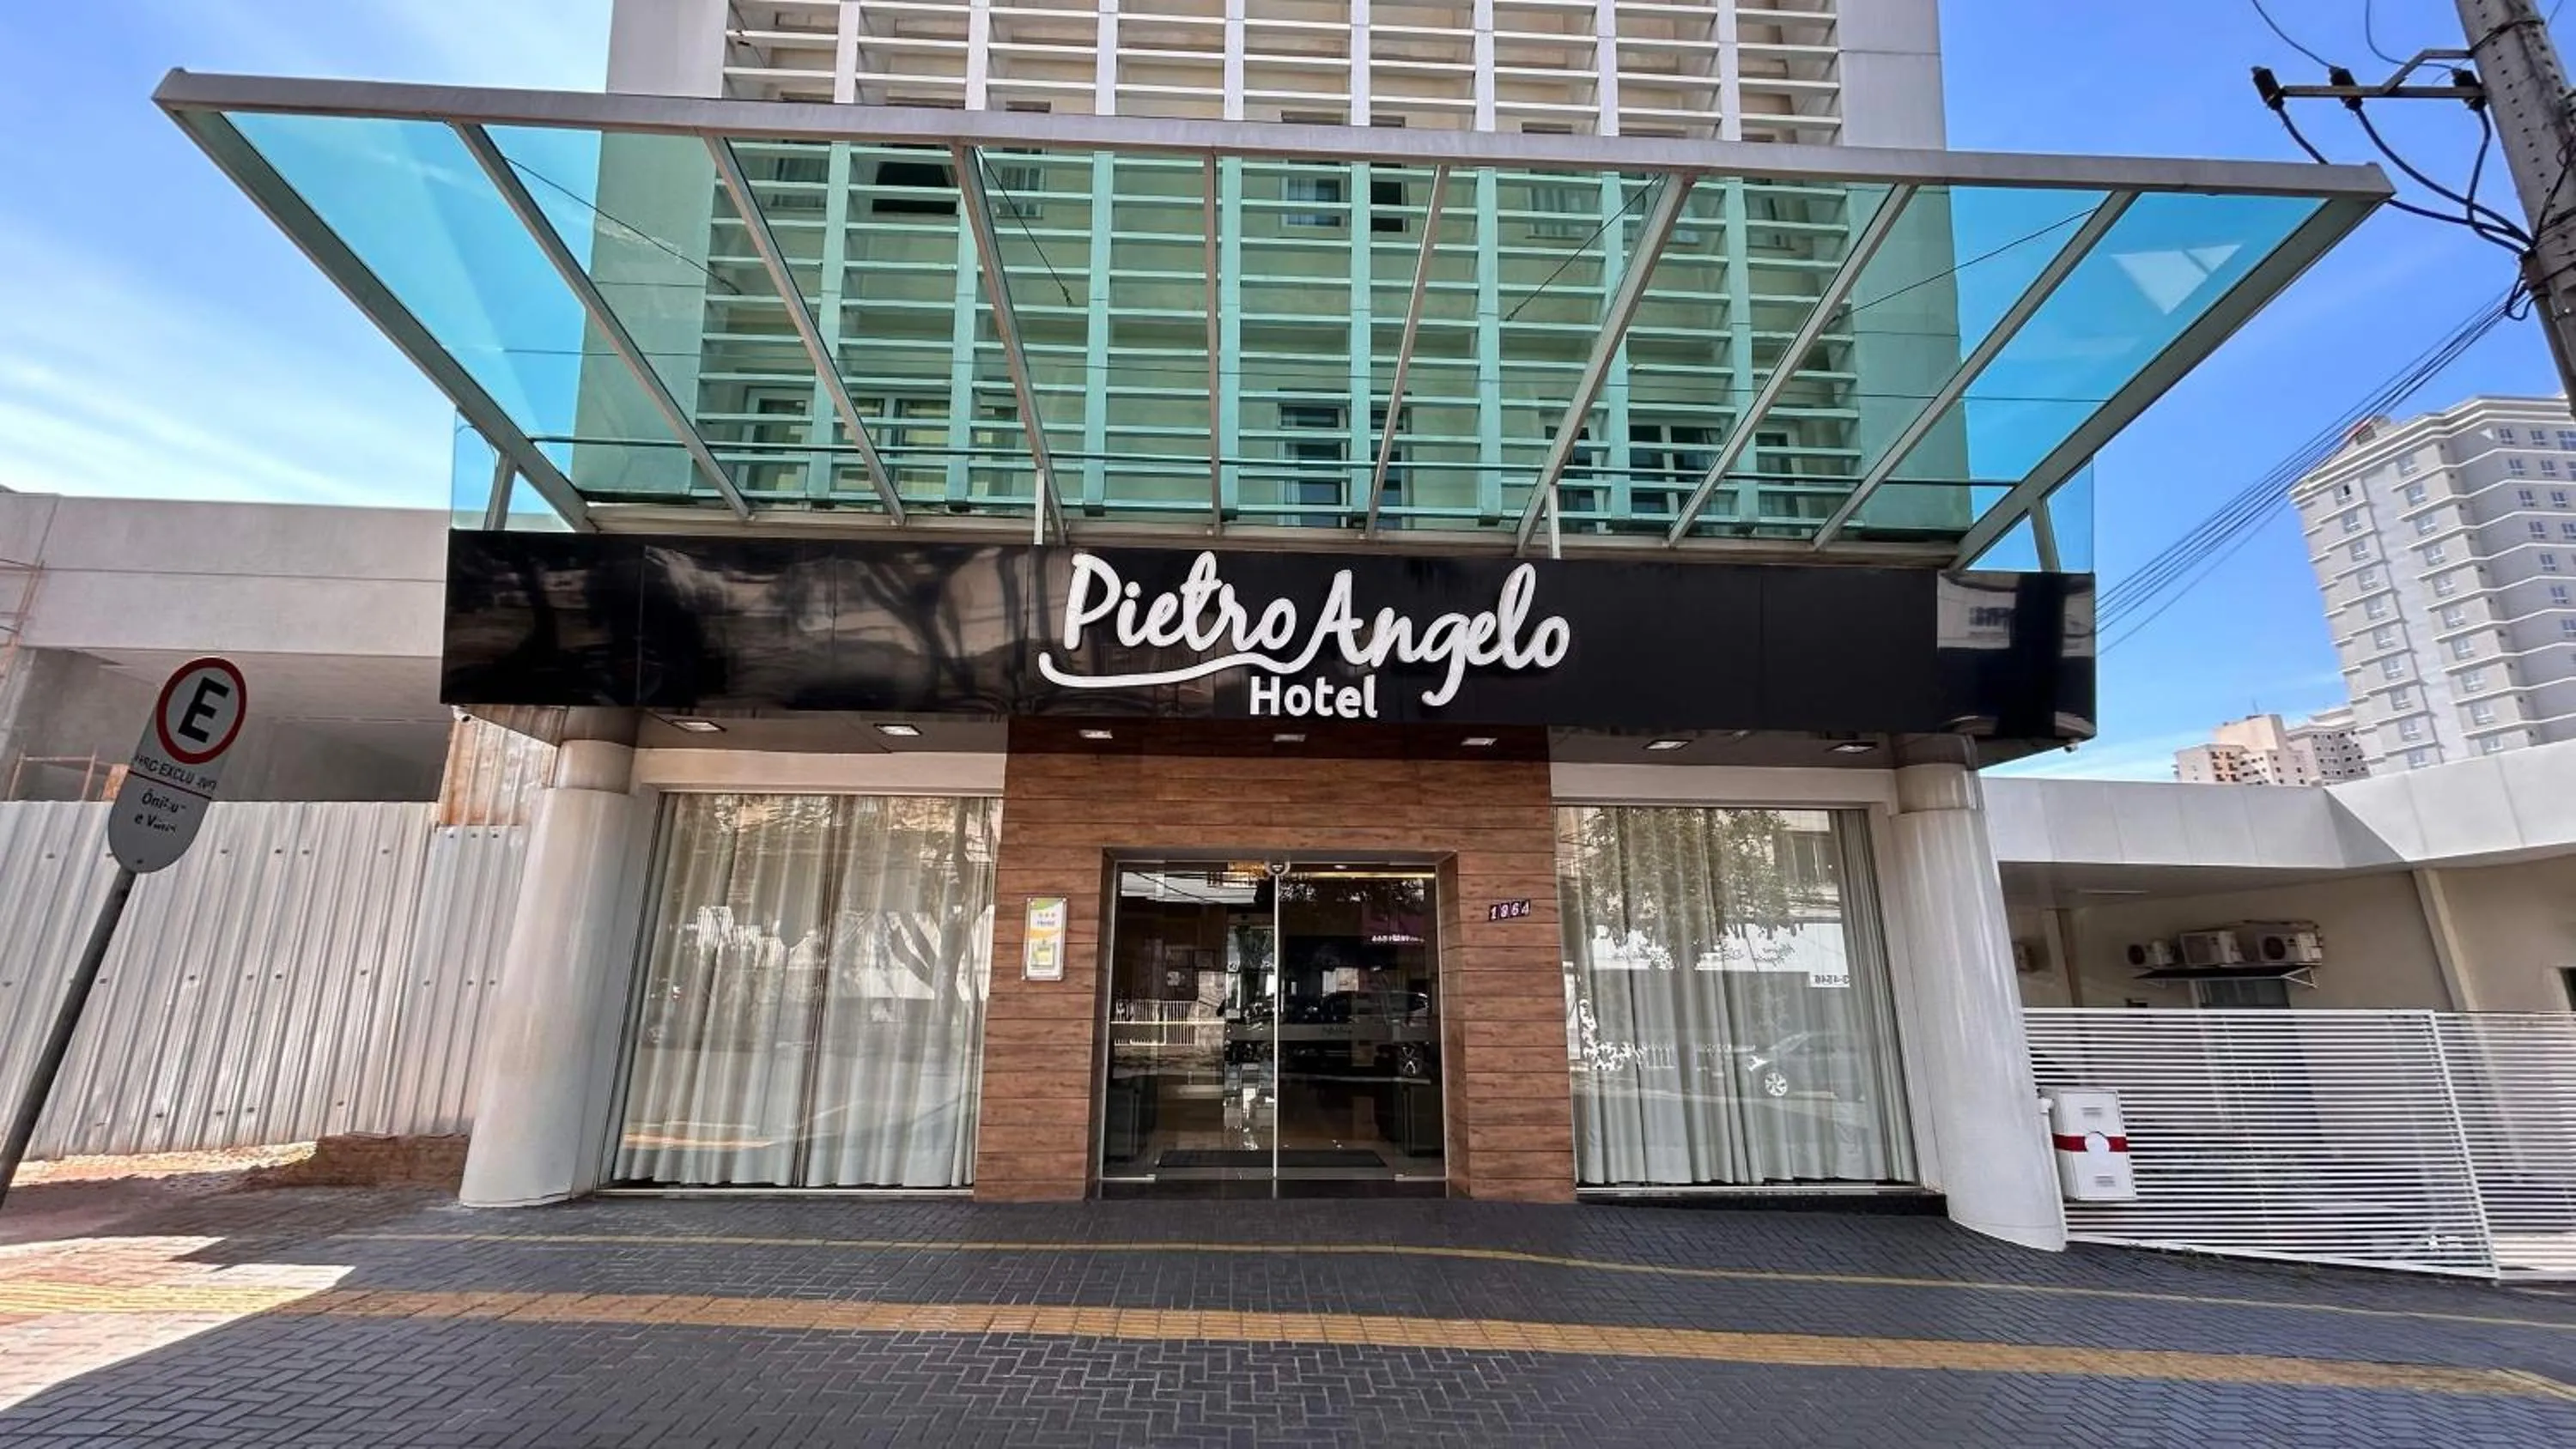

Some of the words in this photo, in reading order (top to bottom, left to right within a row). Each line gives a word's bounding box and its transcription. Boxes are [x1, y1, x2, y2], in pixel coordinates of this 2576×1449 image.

[1064, 550, 1297, 652] Pietro
[1271, 562, 1571, 707] Angelo
[178, 676, 229, 743] E
[1249, 674, 1378, 718] Hotel
